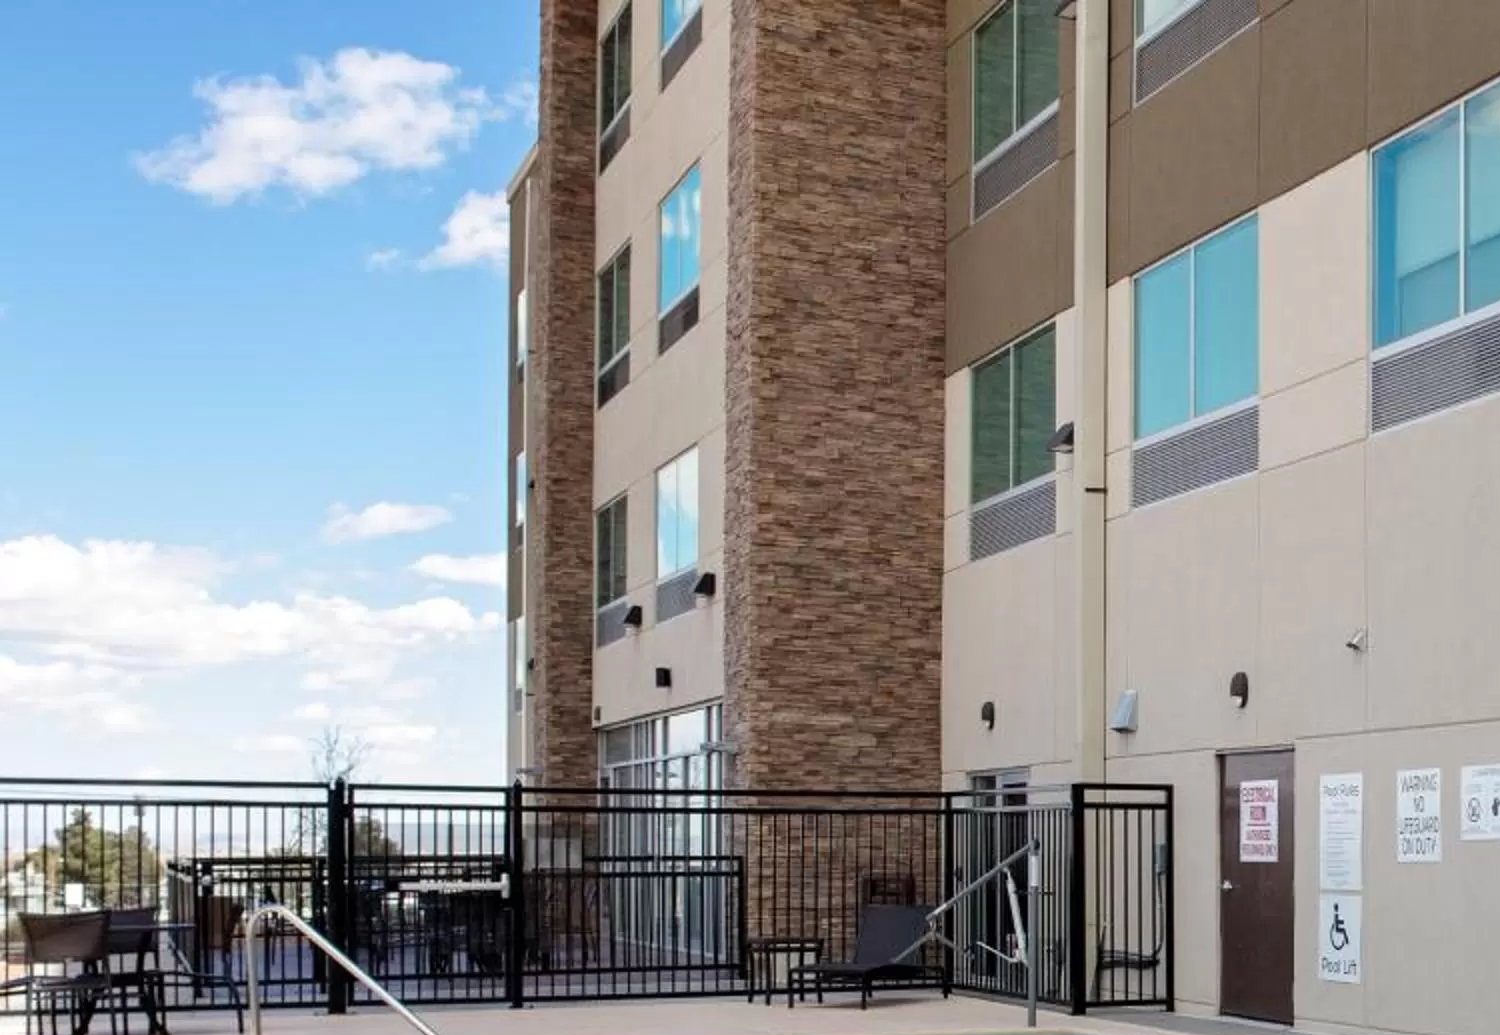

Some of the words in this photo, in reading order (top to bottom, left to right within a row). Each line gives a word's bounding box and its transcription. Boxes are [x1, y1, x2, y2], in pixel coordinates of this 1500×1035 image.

[1401, 774, 1438, 793] WARNING
[1414, 796, 1425, 813] NO
[1400, 816, 1439, 835] LIFEGUARD
[1402, 838, 1414, 856] ON
[1416, 836, 1437, 855] DUTY
[1321, 957, 1341, 974] Pool
